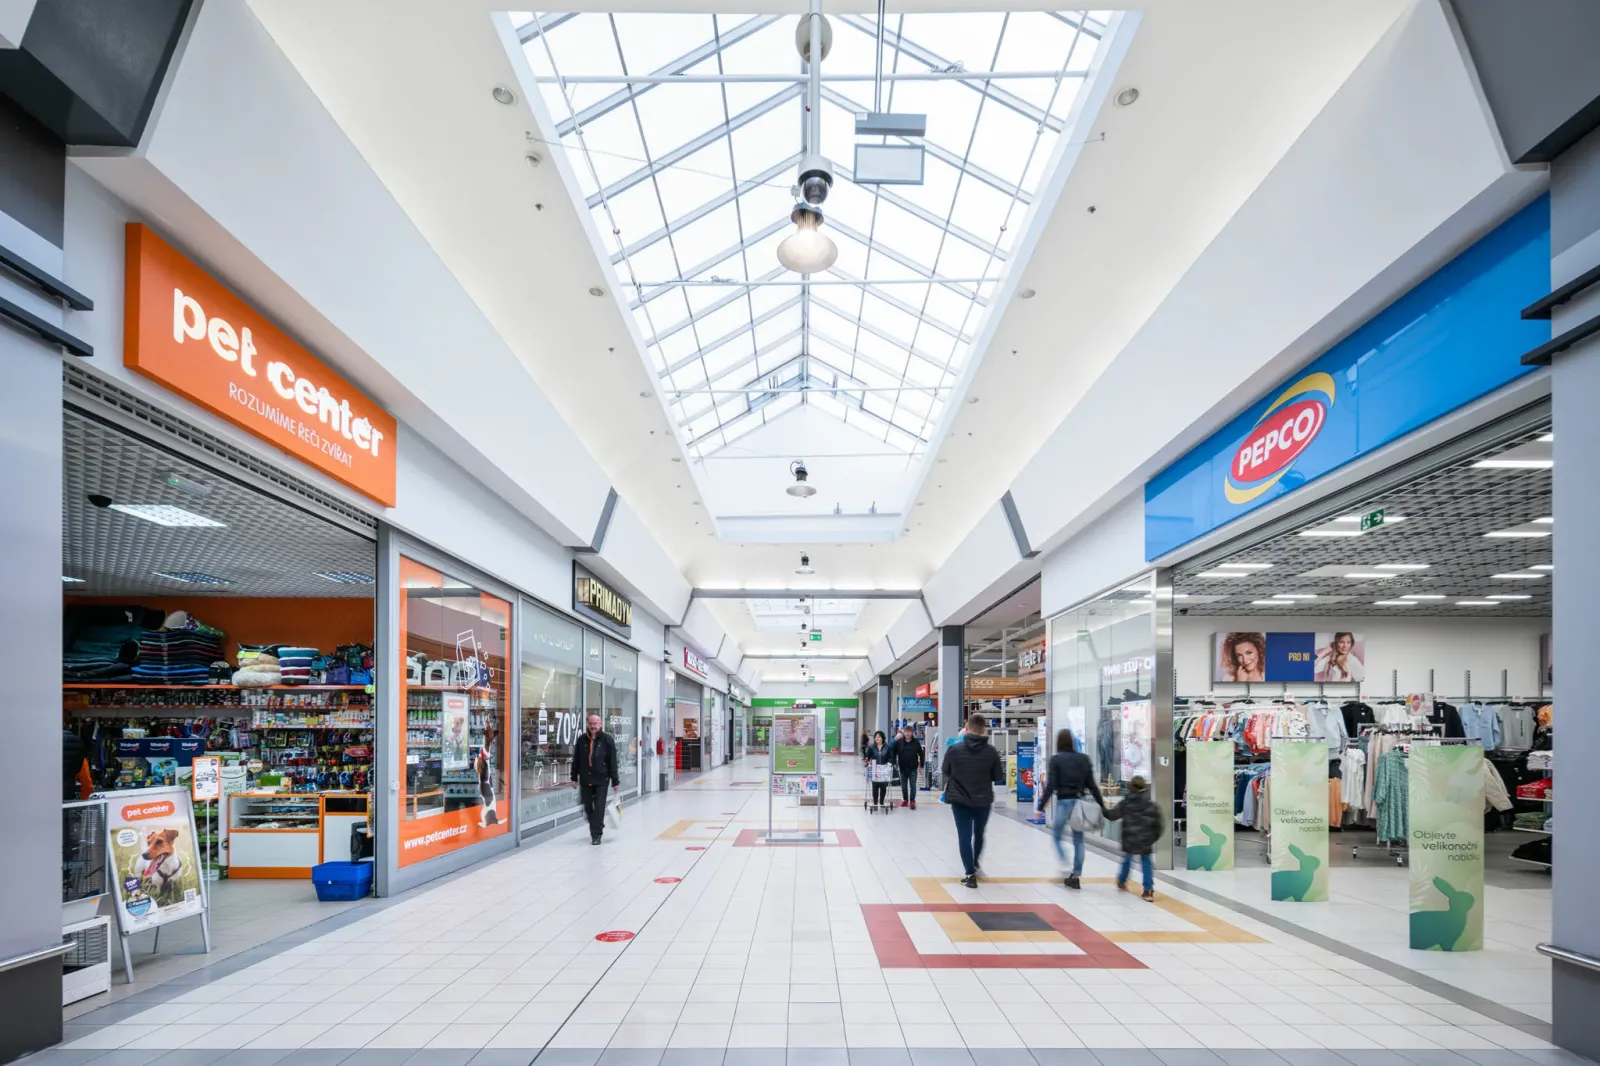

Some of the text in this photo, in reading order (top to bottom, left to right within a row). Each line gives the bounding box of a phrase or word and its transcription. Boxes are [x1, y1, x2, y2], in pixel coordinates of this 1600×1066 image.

[173, 287, 384, 457] pet center
[229, 381, 353, 468] ROZUMÍME ŘEČI ZVÍŘAT
[1238, 407, 1315, 476] PEPCO
[1288, 652, 1310, 662] PRO NI
[1189, 794, 1215, 802] Objevte
[126, 804, 170, 819] pet center
[1274, 808, 1306, 817] Objevte
[404, 824, 468, 850] www.petcenter.cz
[1413, 830, 1457, 841] Objevte
[125, 879, 137, 888] TOP
